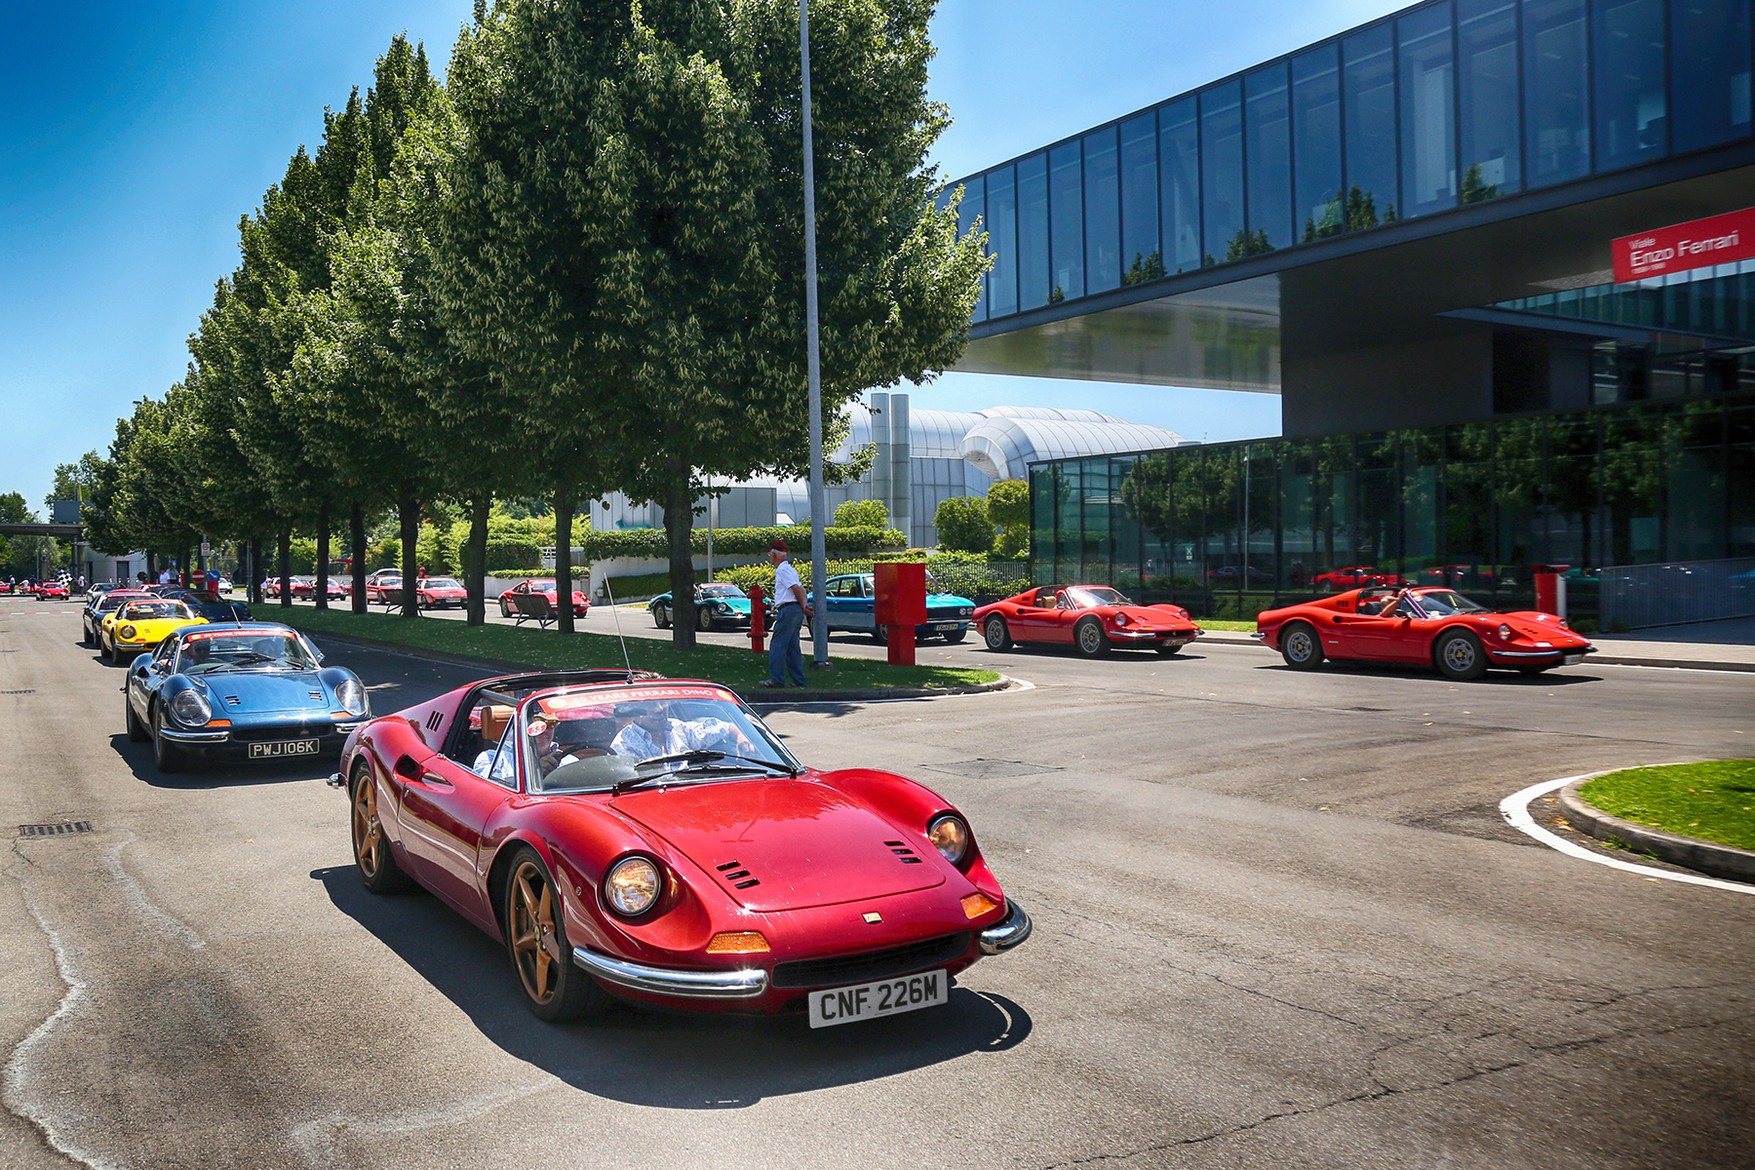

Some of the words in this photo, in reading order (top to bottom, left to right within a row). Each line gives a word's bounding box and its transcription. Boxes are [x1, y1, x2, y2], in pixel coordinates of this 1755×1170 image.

[1629, 237, 1656, 249] Viale
[1630, 247, 1674, 267] Enzo
[1677, 230, 1739, 257] Ferrari
[590, 692, 628, 701] YEARS
[630, 689, 680, 698] FERRARI
[878, 974, 938, 1011] 226M
